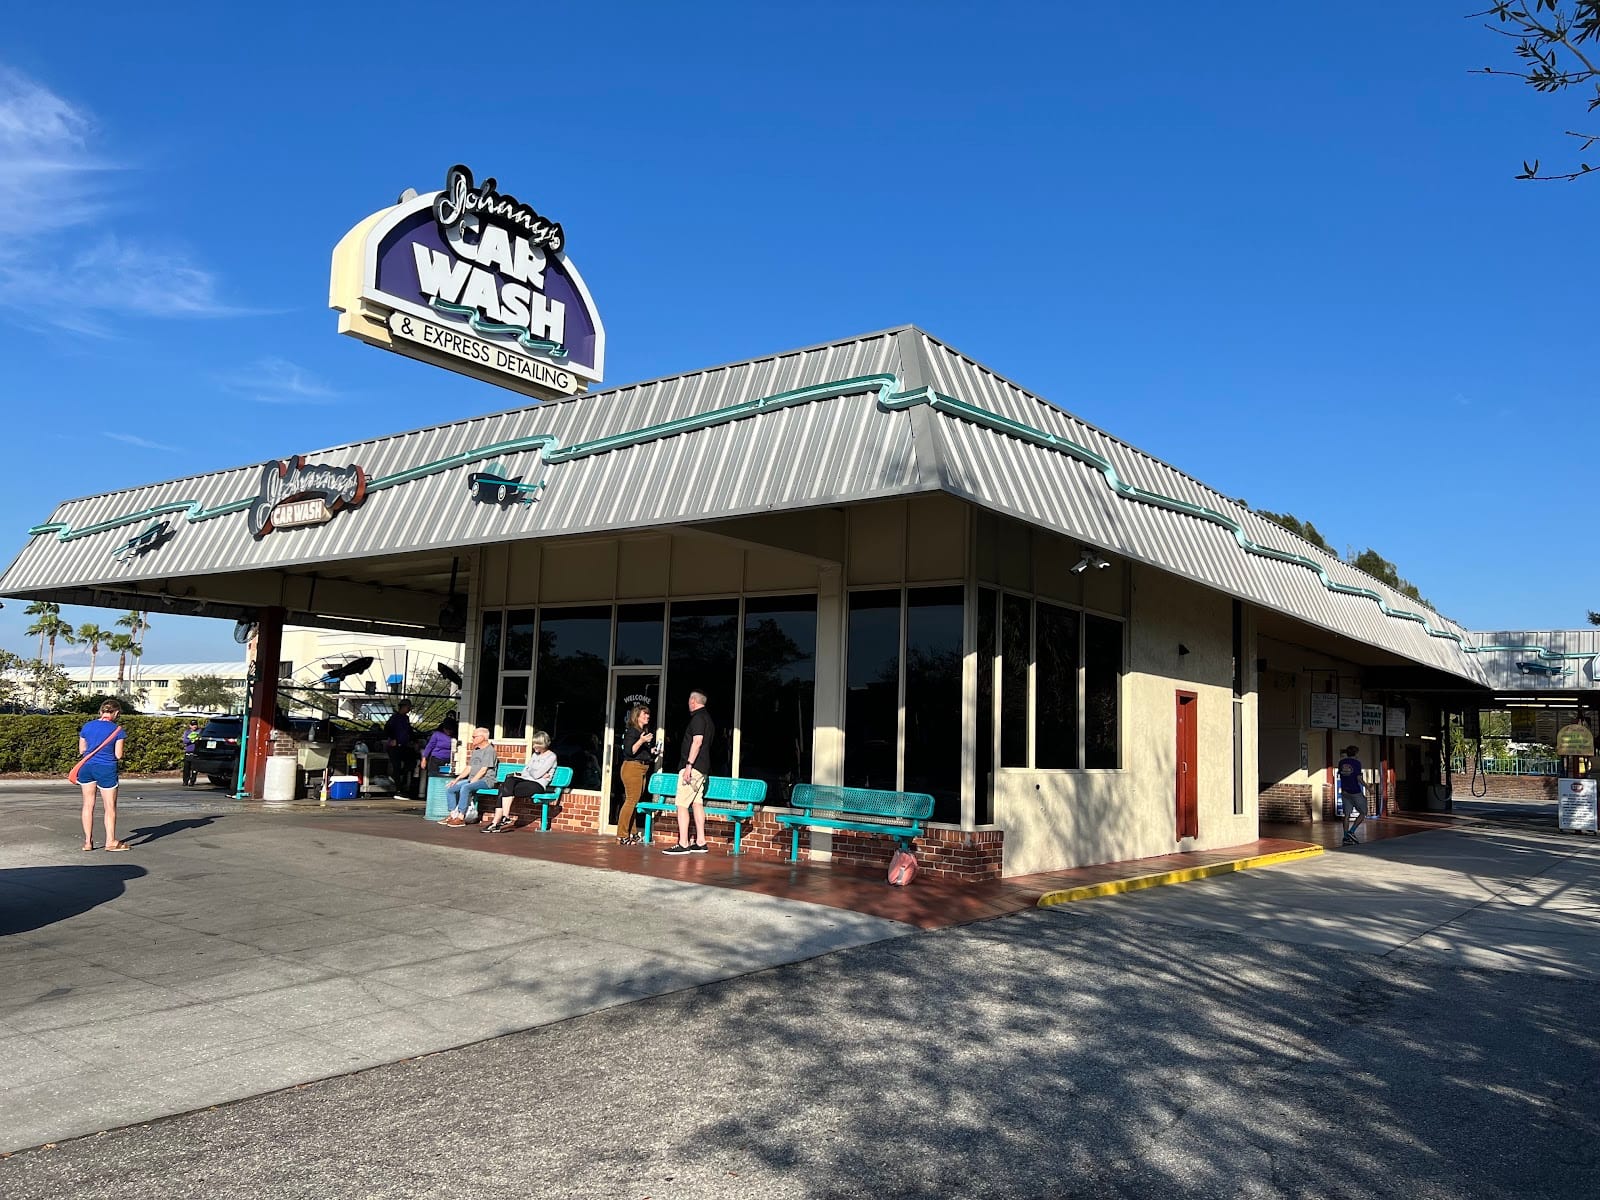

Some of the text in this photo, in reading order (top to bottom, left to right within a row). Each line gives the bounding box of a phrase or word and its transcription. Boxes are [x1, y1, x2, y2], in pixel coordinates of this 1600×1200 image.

[437, 169, 562, 251] Johnny's
[446, 214, 547, 290] CAR
[412, 241, 566, 345] WASH
[400, 316, 569, 389] & EXPRESS DETAILING
[273, 500, 321, 525] CAR WASH
[624, 694, 651, 704] WELCOME
